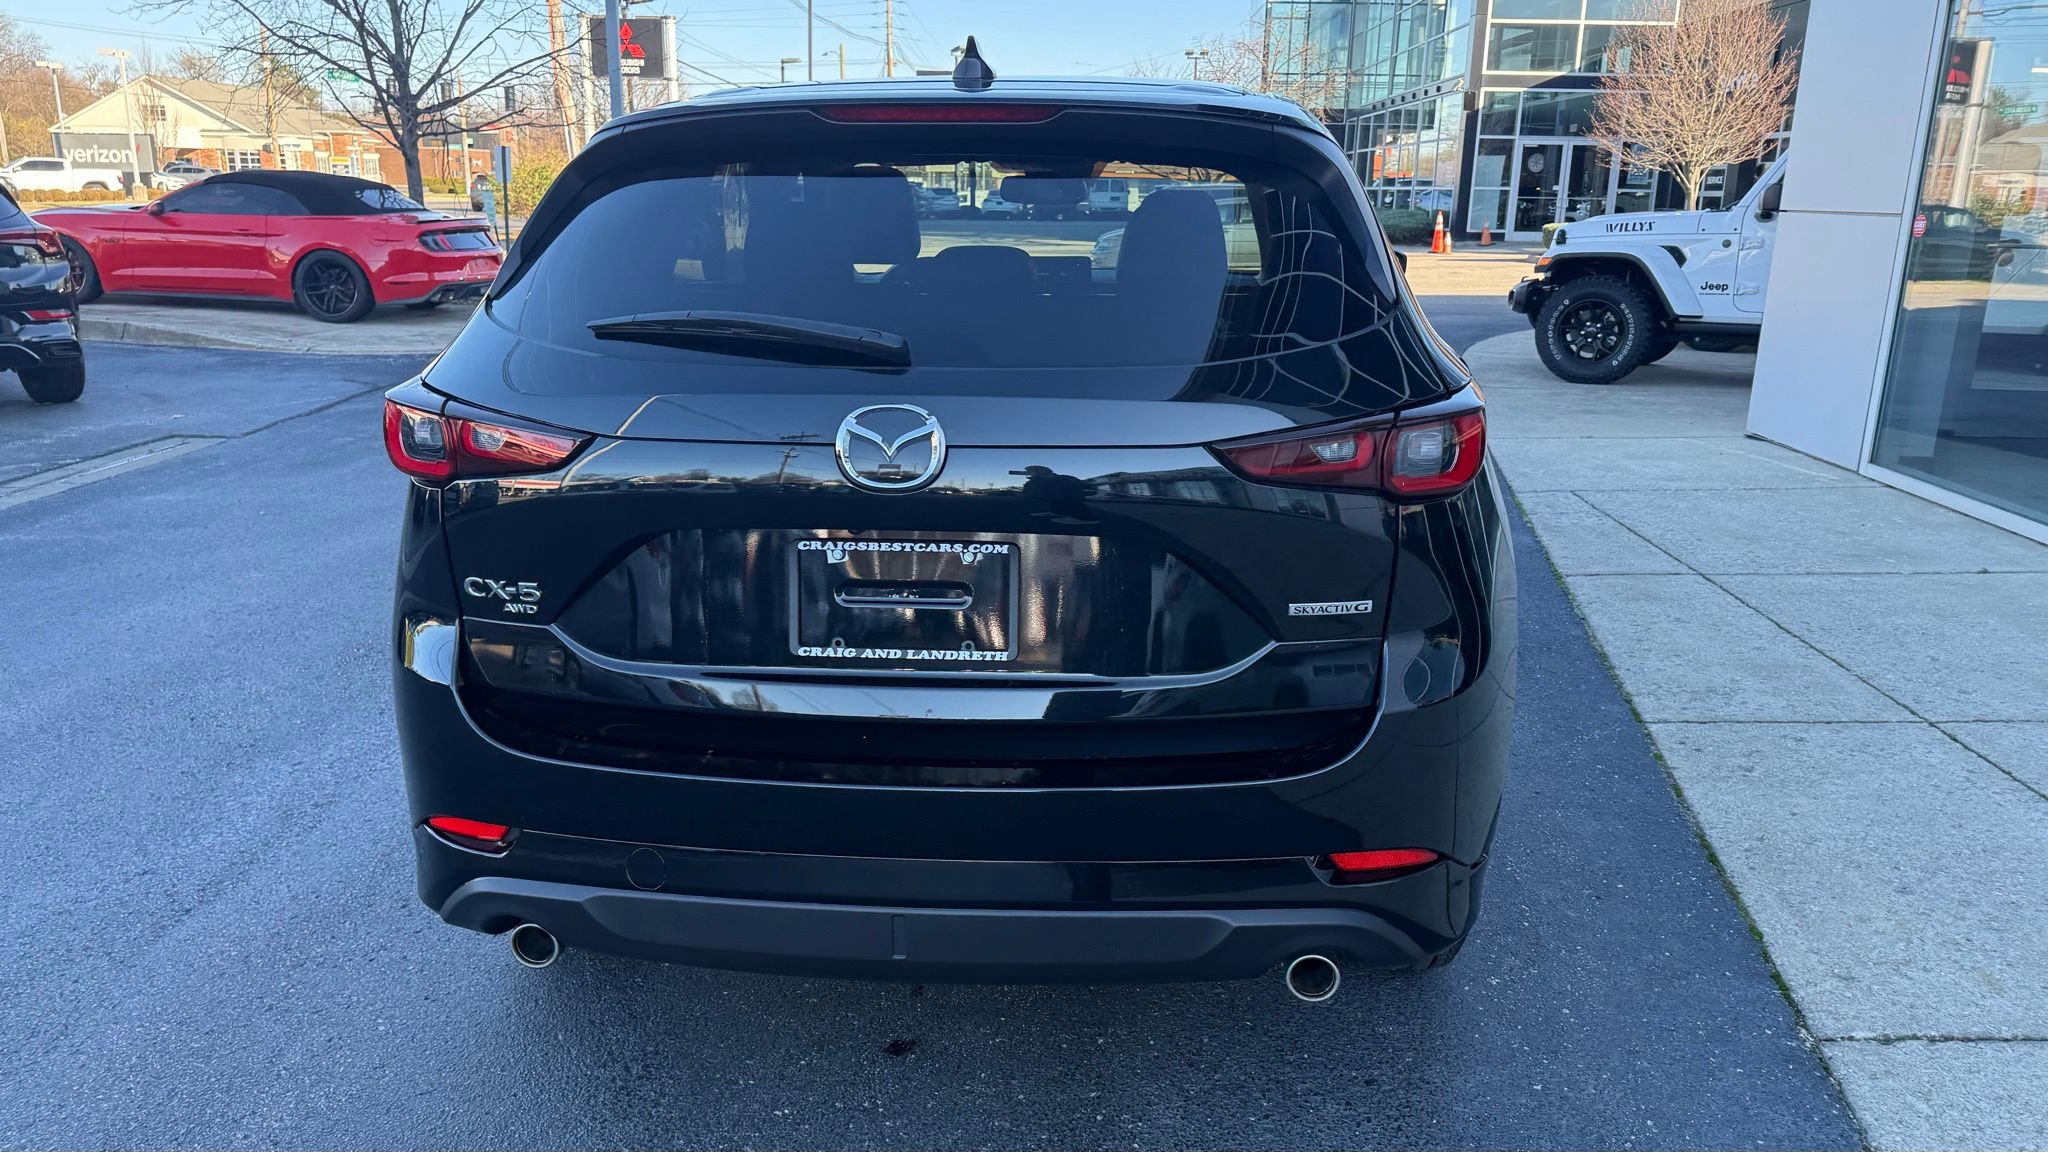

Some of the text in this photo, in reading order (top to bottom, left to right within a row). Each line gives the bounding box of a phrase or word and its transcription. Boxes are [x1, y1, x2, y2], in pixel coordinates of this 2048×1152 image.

[63, 144, 134, 163] verizon
[1706, 176, 1724, 184] SERVICE
[1605, 221, 1656, 233] WILLYS
[1700, 281, 1729, 292] Jeep
[797, 540, 1010, 554] CRAIGSBESTCARS.COM
[464, 576, 542, 602] CX-5
[502, 602, 538, 614] AWD
[797, 646, 1009, 661] CRAIG AND LANDRETH
